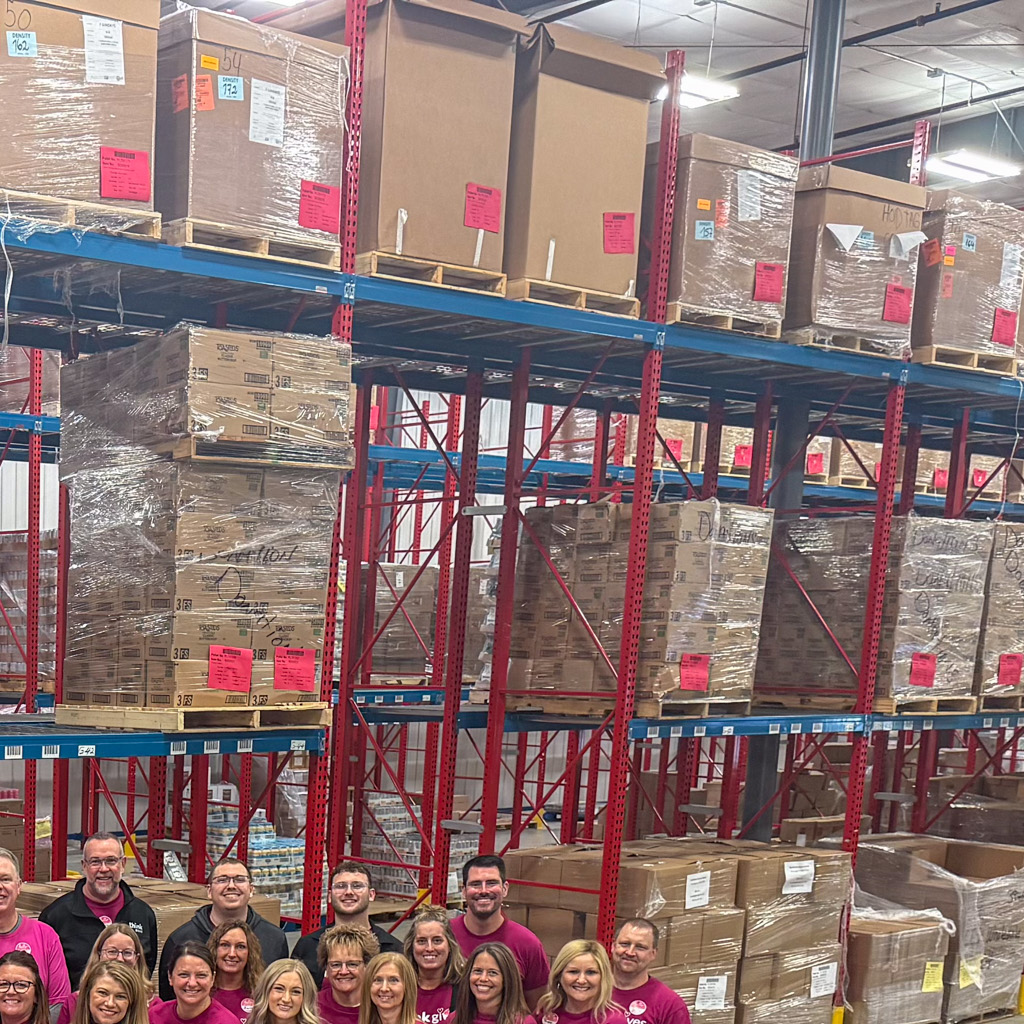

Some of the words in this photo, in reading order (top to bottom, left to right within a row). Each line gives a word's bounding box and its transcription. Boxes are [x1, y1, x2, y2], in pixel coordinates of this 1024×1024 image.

[12, 39, 29, 52] 162
[222, 47, 242, 76] 54
[176, 599, 181, 611] 3
[173, 648, 178, 659] 3
[180, 648, 189, 659] FS
[258, 649, 267, 660] FS
[177, 695, 182, 706] 3
[183, 695, 193, 706] FS
[252, 695, 257, 706] 3
[258, 695, 268, 706] FS
